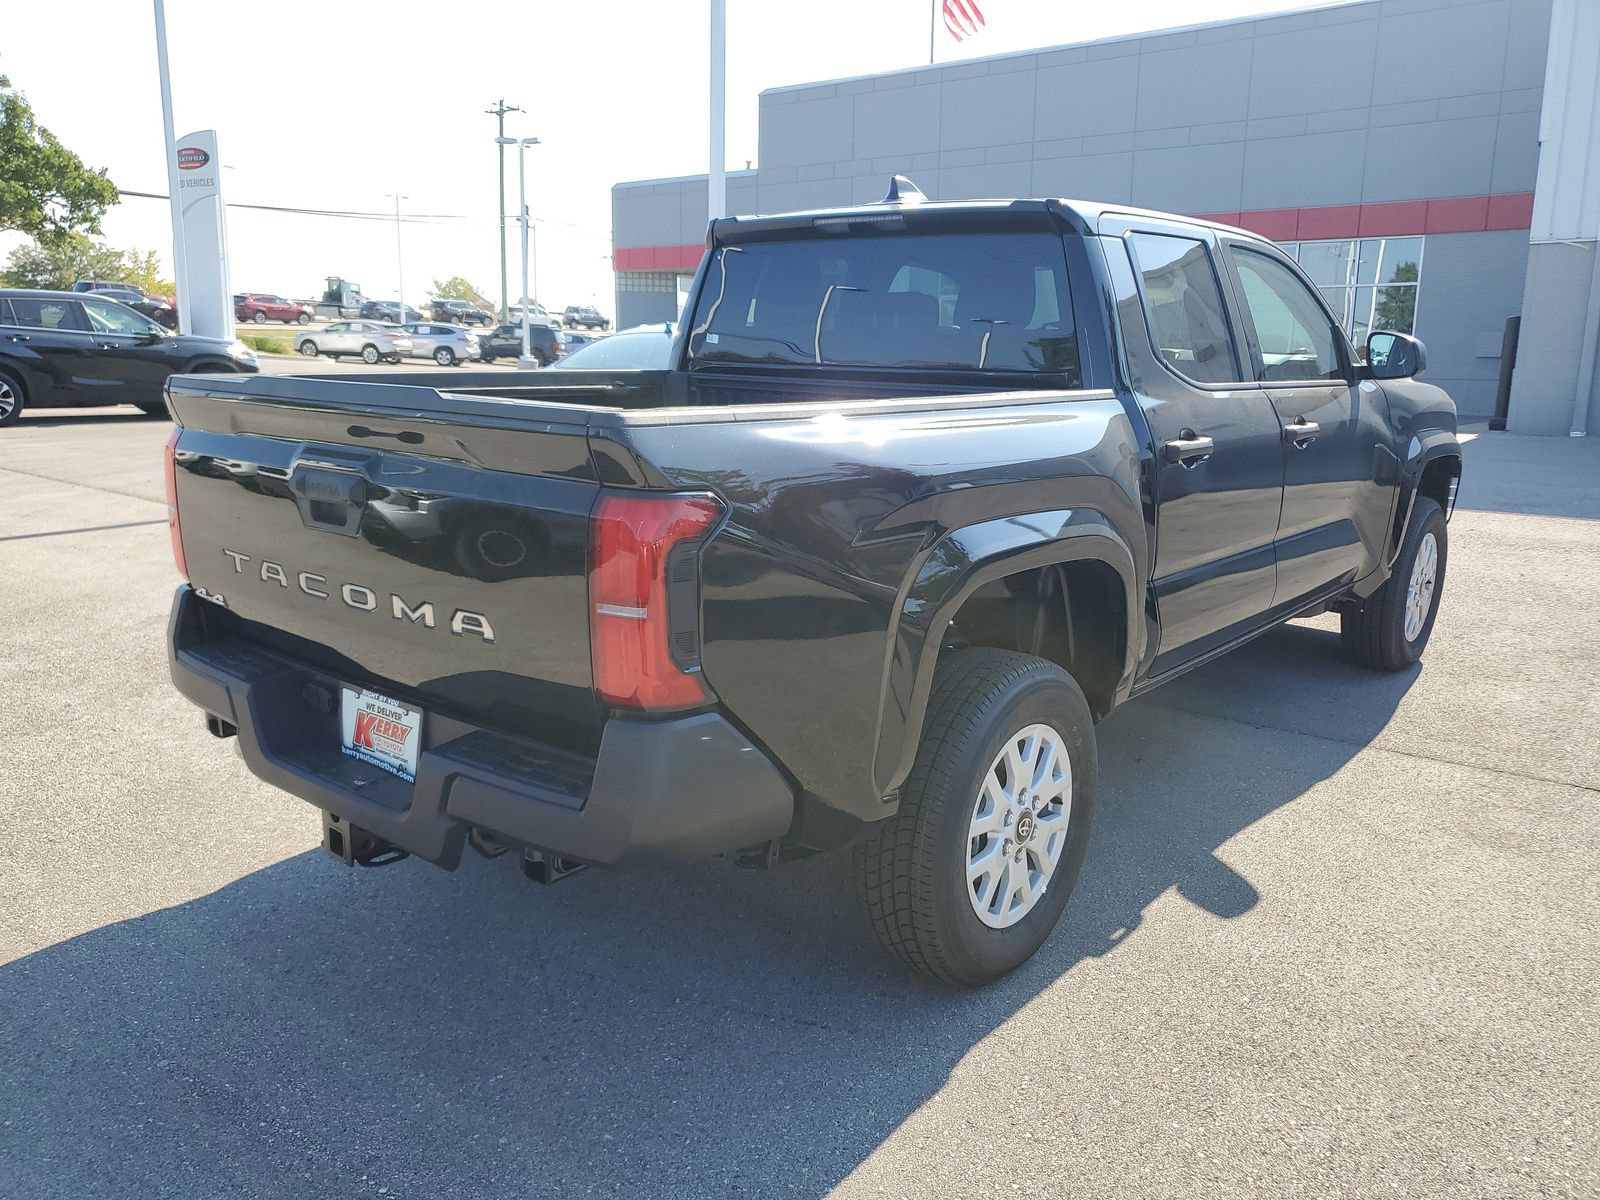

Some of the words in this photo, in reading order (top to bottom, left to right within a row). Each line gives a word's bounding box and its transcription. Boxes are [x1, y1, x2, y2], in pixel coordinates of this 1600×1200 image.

[186, 178, 215, 187] VEHICLES
[223, 548, 496, 643] TACOMA
[362, 689, 379, 700] RIGHT
[379, 694, 387, 703] BY
[387, 697, 400, 707] YOU
[366, 702, 376, 713] WE
[376, 705, 403, 721] DELIVER
[354, 710, 411, 750] KERRY
[382, 739, 403, 754] TOYOTA
[341, 745, 415, 784] kerryautomotive.com
